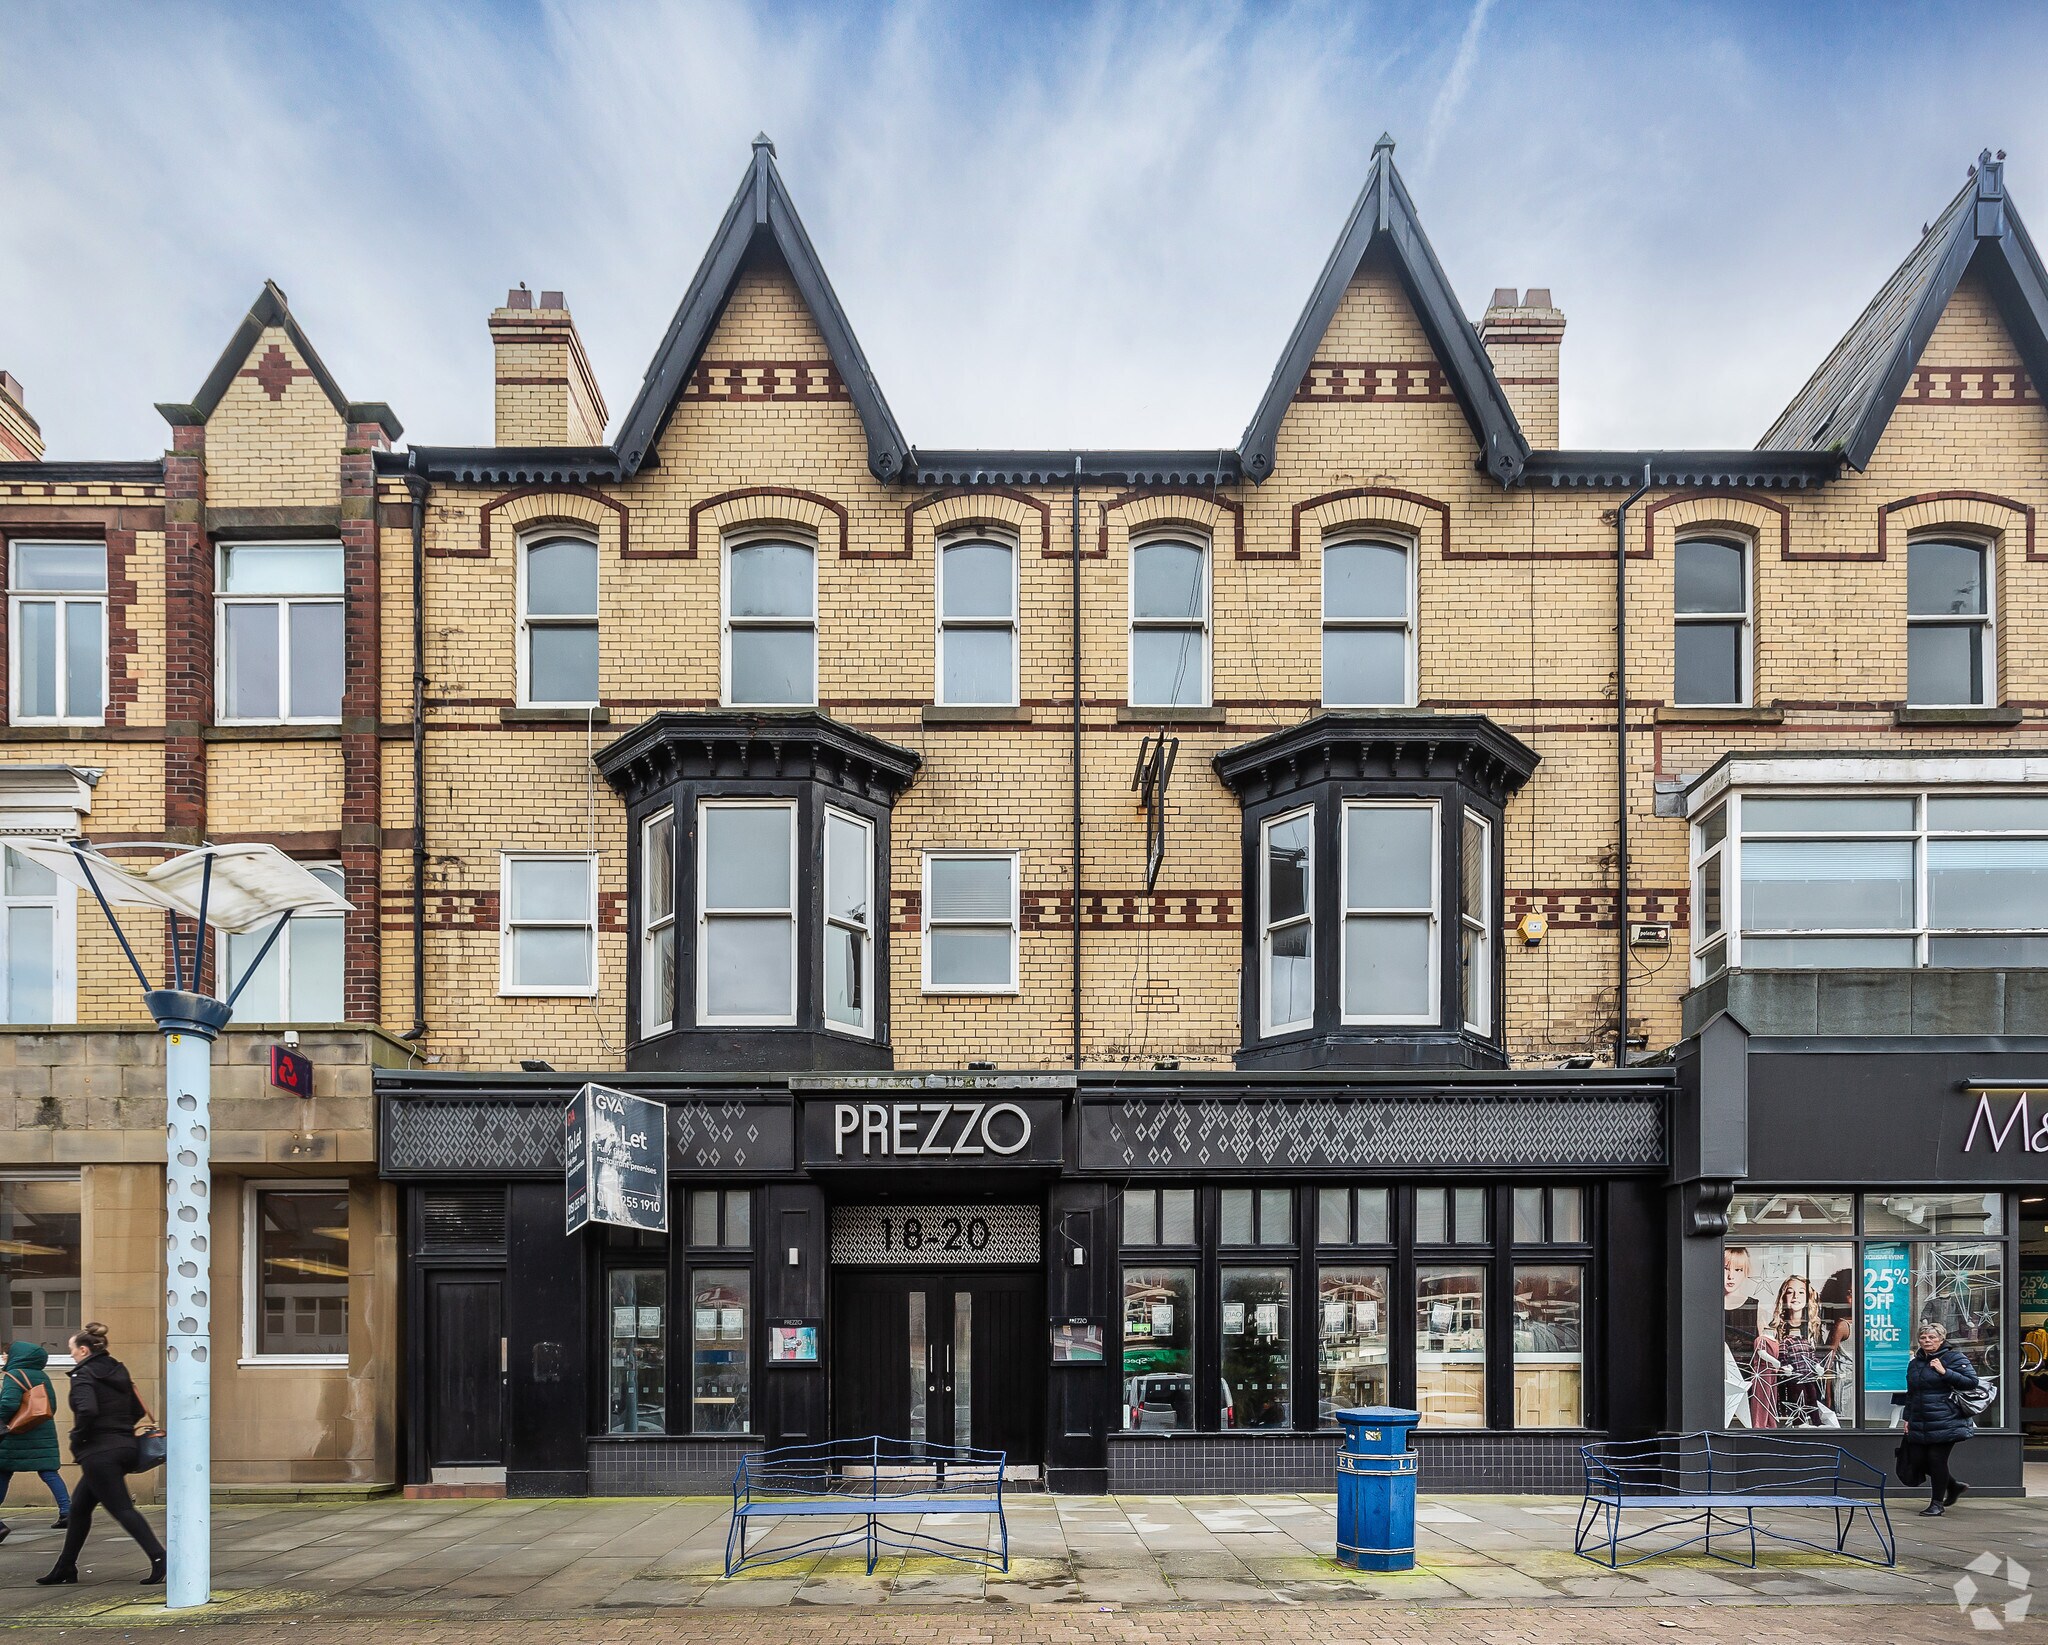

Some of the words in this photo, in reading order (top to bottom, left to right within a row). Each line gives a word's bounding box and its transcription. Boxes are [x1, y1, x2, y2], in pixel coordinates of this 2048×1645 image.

[172, 1034, 179, 1044] 5
[595, 1094, 625, 1115] GVA
[621, 1124, 648, 1150] Let
[835, 1103, 1031, 1154] PREZZO
[597, 1156, 630, 1169] restaurant
[630, 1163, 657, 1174] premises
[640, 1199, 661, 1212] 1910
[881, 1217, 990, 1250] 18-20
[1864, 1268, 1909, 1294] 25%
[2021, 1276, 2048, 1289] 25%
[1864, 1293, 1894, 1310] OFF
[2020, 1289, 2037, 1298] OFF
[1864, 1314, 1895, 1328] FULL
